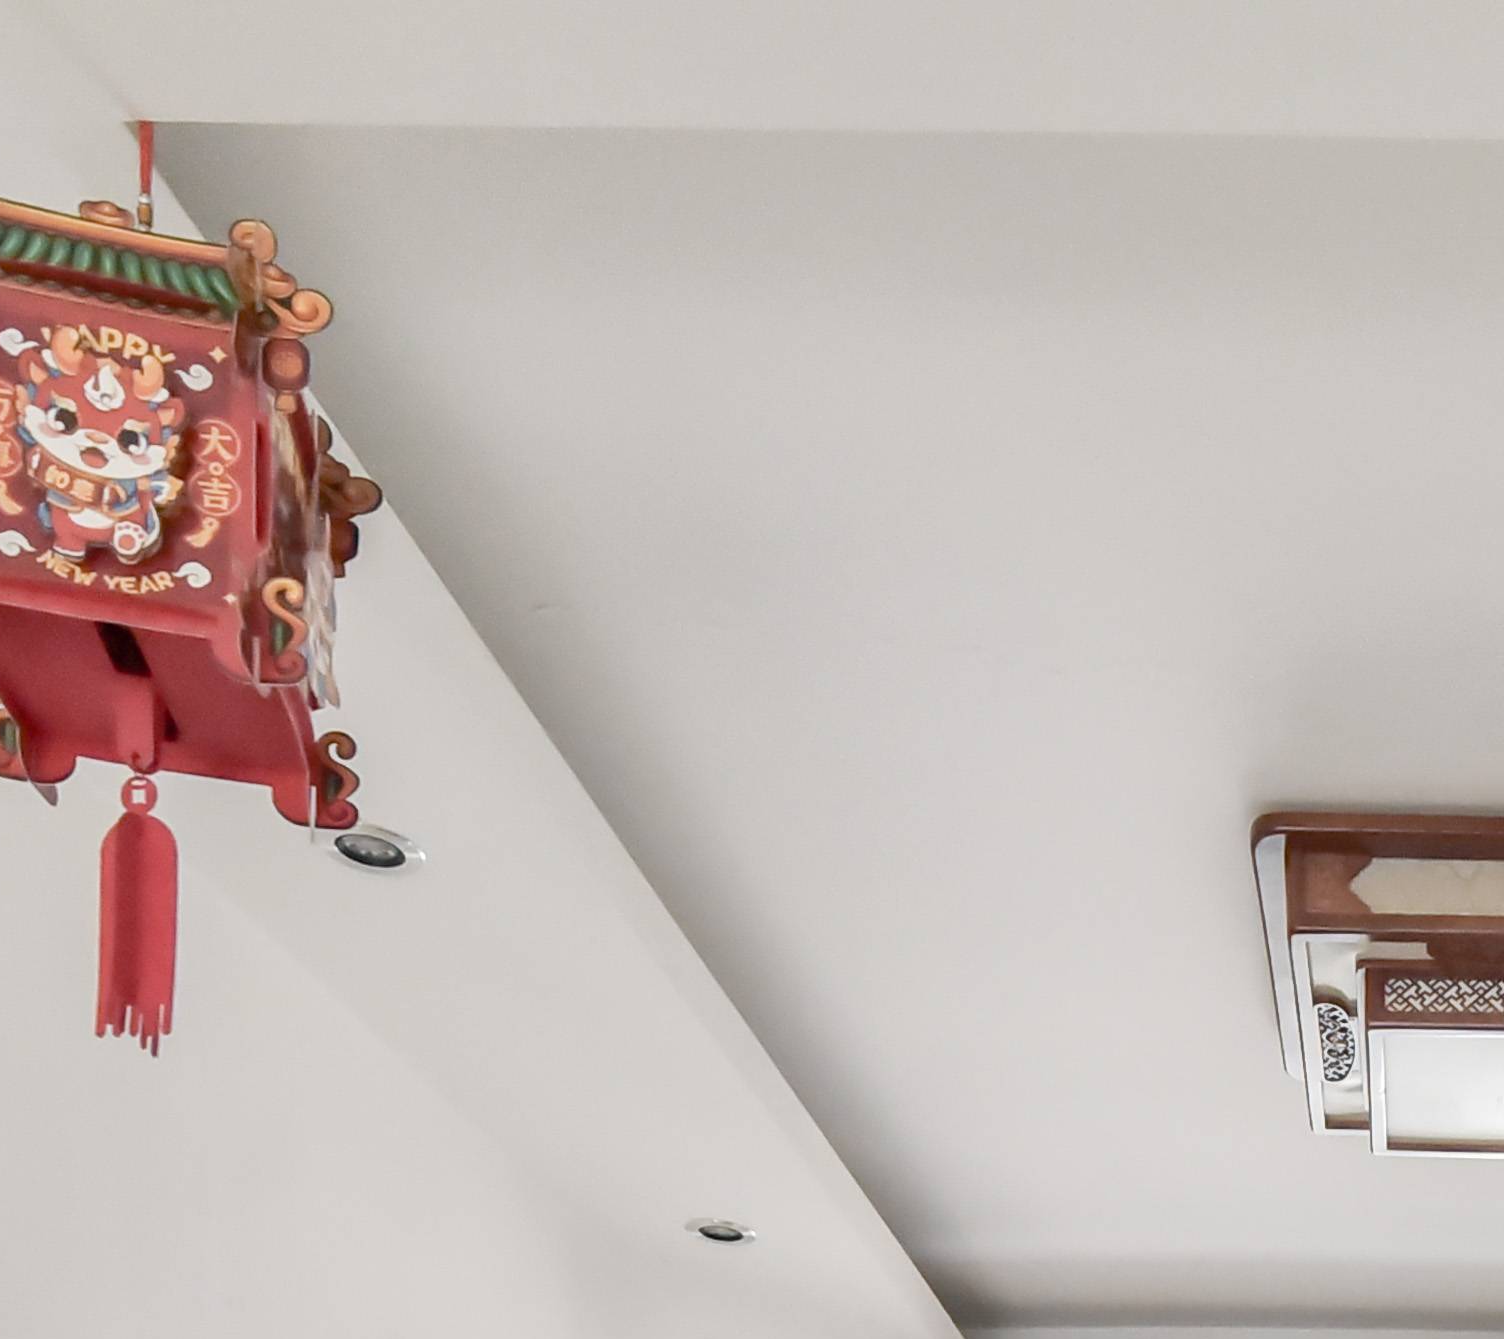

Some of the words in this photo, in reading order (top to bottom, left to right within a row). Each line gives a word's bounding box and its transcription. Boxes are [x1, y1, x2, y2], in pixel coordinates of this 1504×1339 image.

[40, 323, 177, 364] APPY
[197, 426, 234, 511] 大吉
[36, 549, 98, 587] NEW
[102, 569, 176, 595] YEAR
